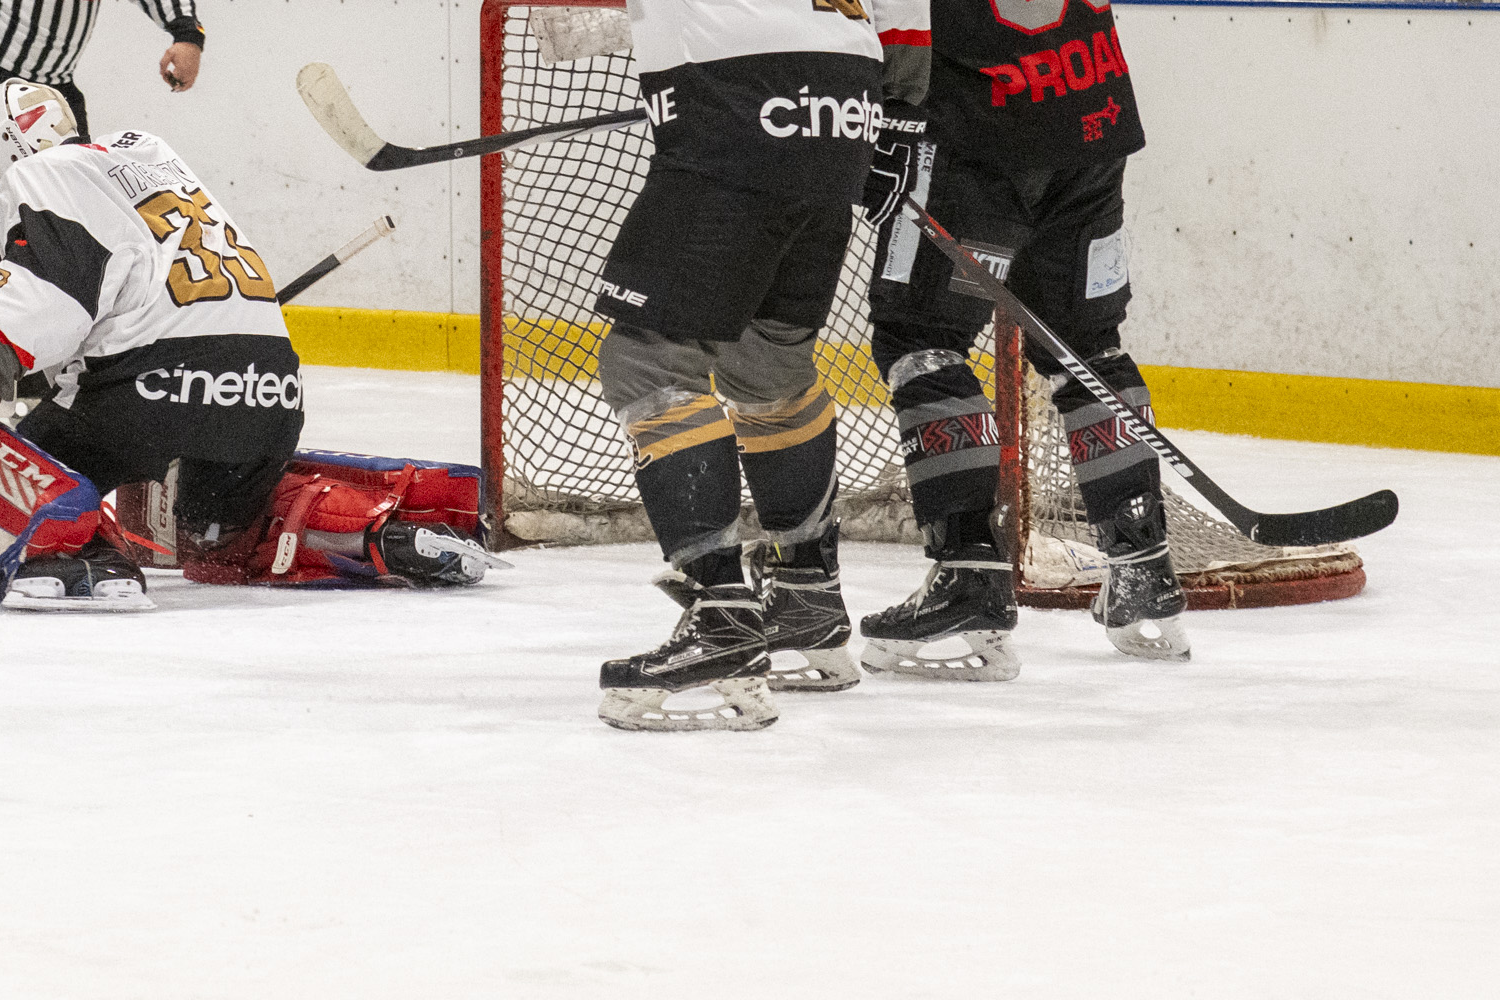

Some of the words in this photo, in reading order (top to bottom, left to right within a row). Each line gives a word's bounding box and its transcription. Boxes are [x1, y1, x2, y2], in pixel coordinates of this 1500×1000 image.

[1060, 354, 1185, 471] WARRIOR
[159, 483, 169, 529] CCM
[281, 534, 293, 567] CCM
